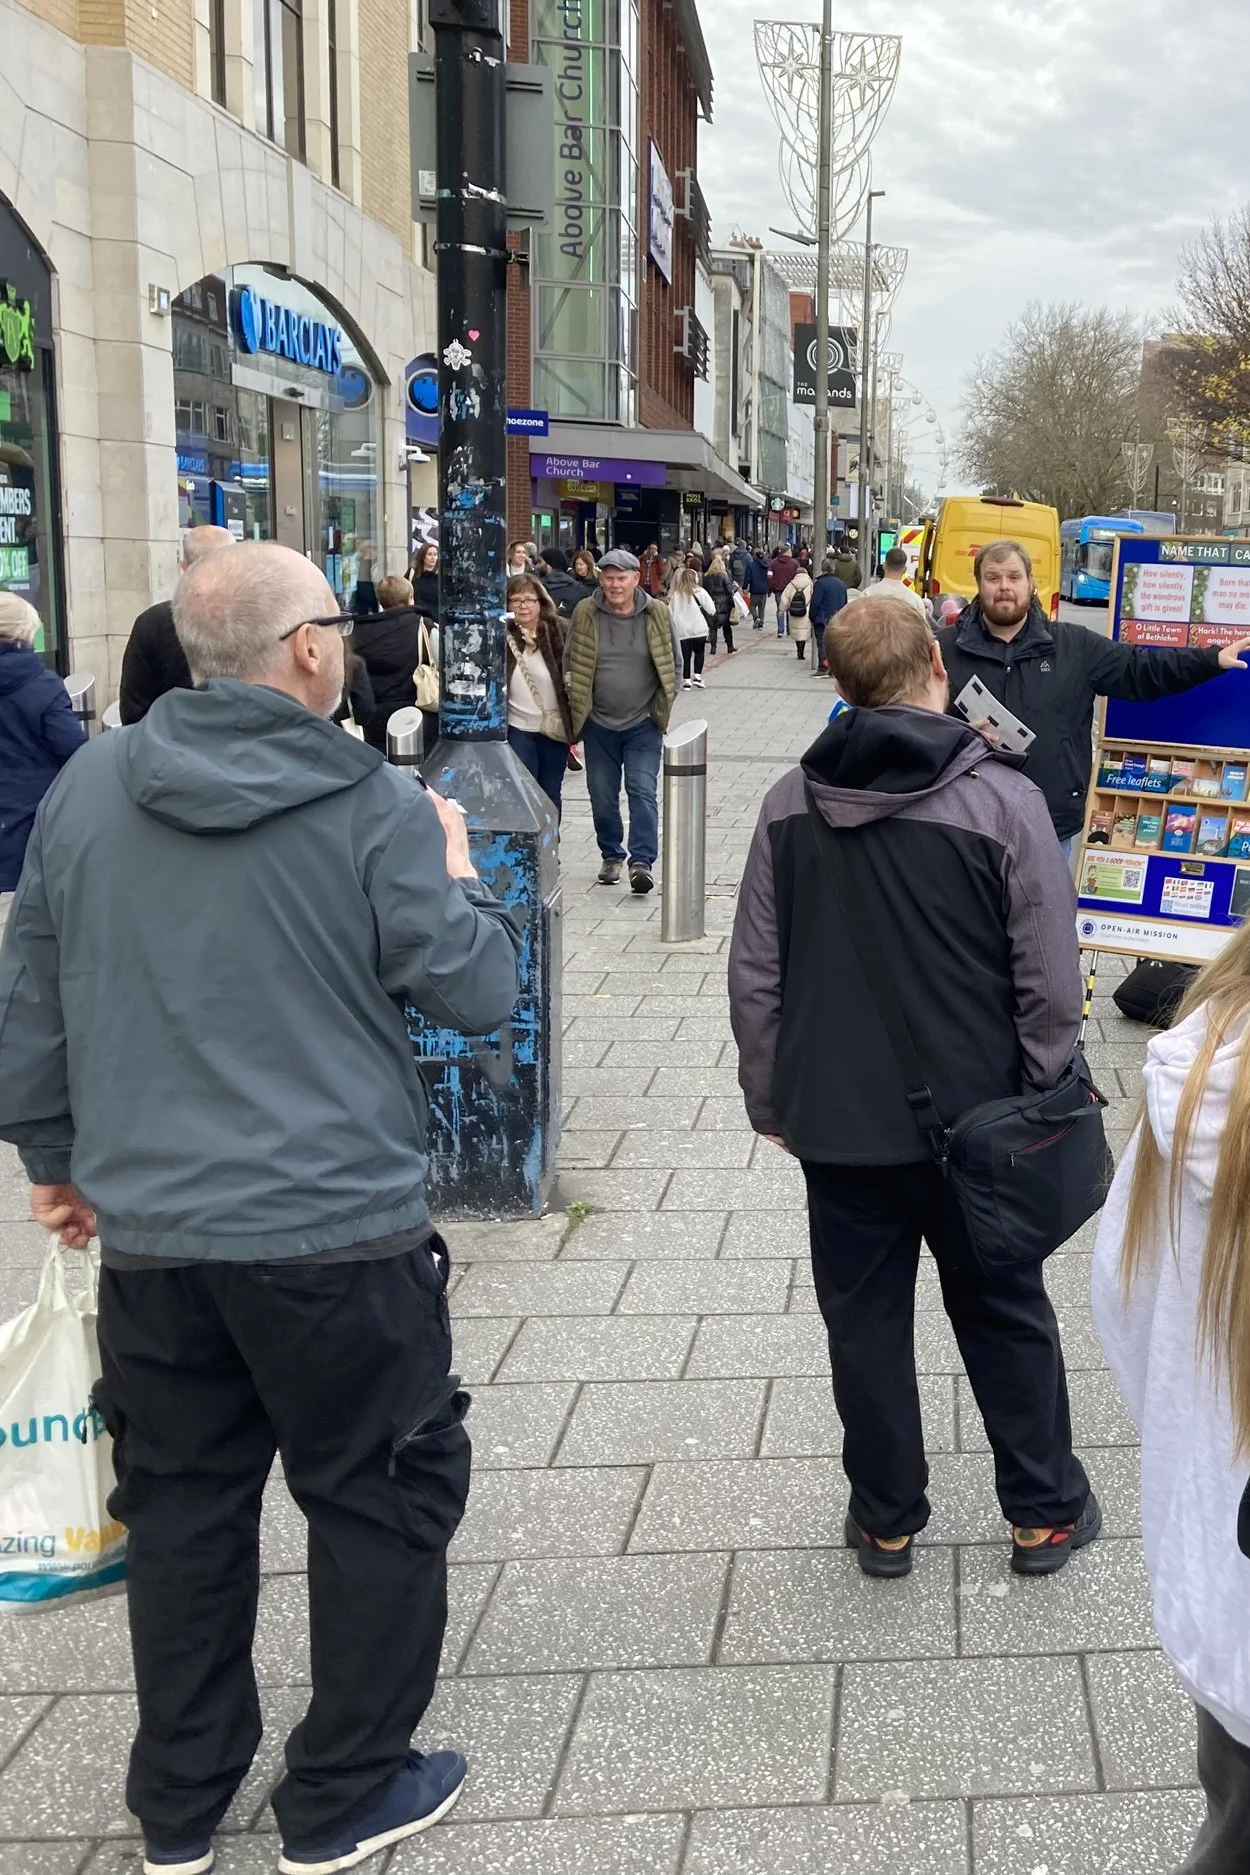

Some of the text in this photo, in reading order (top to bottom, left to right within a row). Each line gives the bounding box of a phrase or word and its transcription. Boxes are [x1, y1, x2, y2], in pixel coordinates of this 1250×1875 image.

[557, 0, 584, 259] Above Bar Church
[264, 299, 344, 377] BARCLAYS
[796, 386, 852, 399] maands
[506, 417, 545, 427] hoezone
[545, 456, 601, 469] Above Bar
[545, 466, 584, 477] Church
[0, 487, 31, 516] MBERS
[1161, 545, 1194, 557] NAME
[1196, 546, 1228, 558] THAT
[11, 549, 27, 578] OFF
[1143, 569, 1186, 581] How silently,
[1142, 581, 1185, 592] how silently,
[1219, 577, 1236, 586] Born
[1140, 592, 1186, 602] the wondrous
[1211, 590, 1228, 598] man
[1228, 591, 1237, 599] no
[1141, 603, 1153, 613] gift
[1162, 604, 1184, 614] given!
[1218, 601, 1248, 611] may die.
[1135, 623, 1182, 633] O Little Town
[1197, 626, 1219, 636] Hark!
[1219, 627, 1234, 635] The
[1137, 631, 1145, 640] of
[1206, 636, 1231, 646] angels
[1106, 773, 1162, 788] Free leaflets
[1100, 923, 1141, 935] OPEN-AIR
[1143, 929, 1179, 940] MISSION
[0, 1530, 56, 1558] zing
